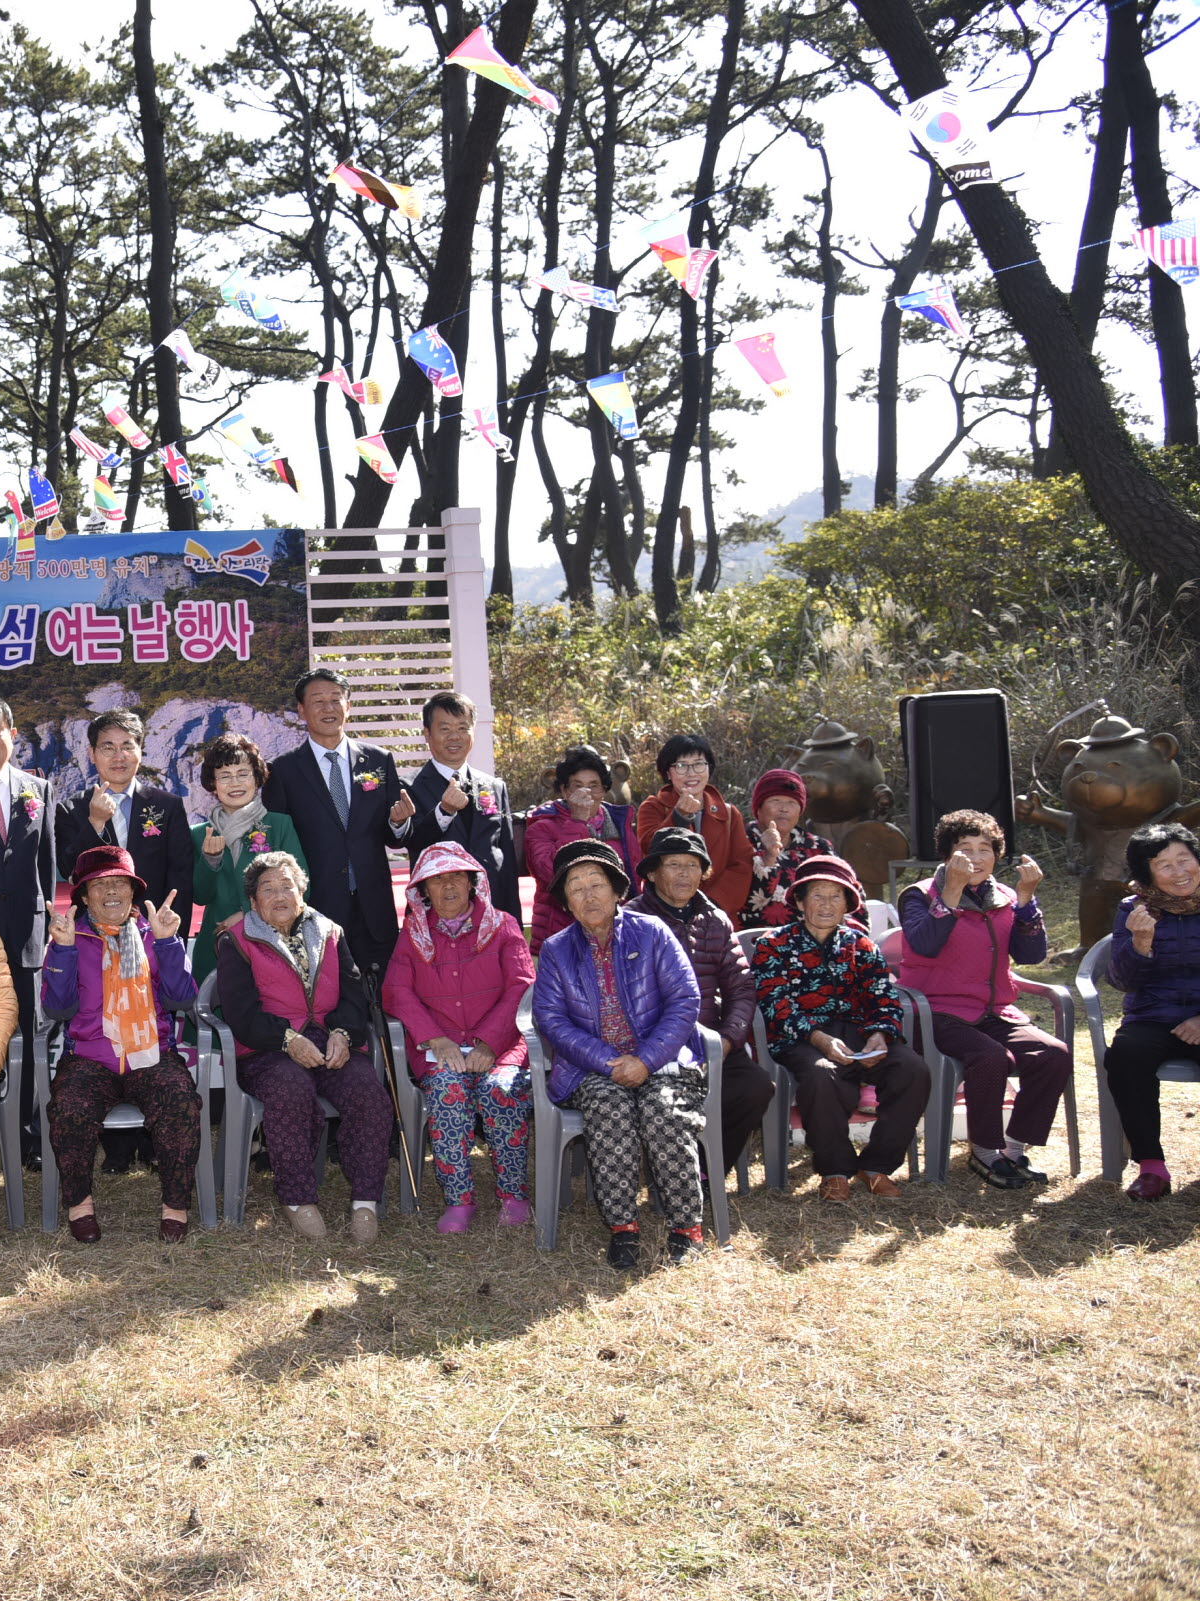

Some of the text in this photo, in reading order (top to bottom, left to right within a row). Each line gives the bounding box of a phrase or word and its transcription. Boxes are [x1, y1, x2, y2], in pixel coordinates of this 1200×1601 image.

[37, 556, 107, 579] 500만명
[45, 603, 124, 665] 여는
[128, 600, 171, 663] 날
[175, 599, 254, 663] 행사
